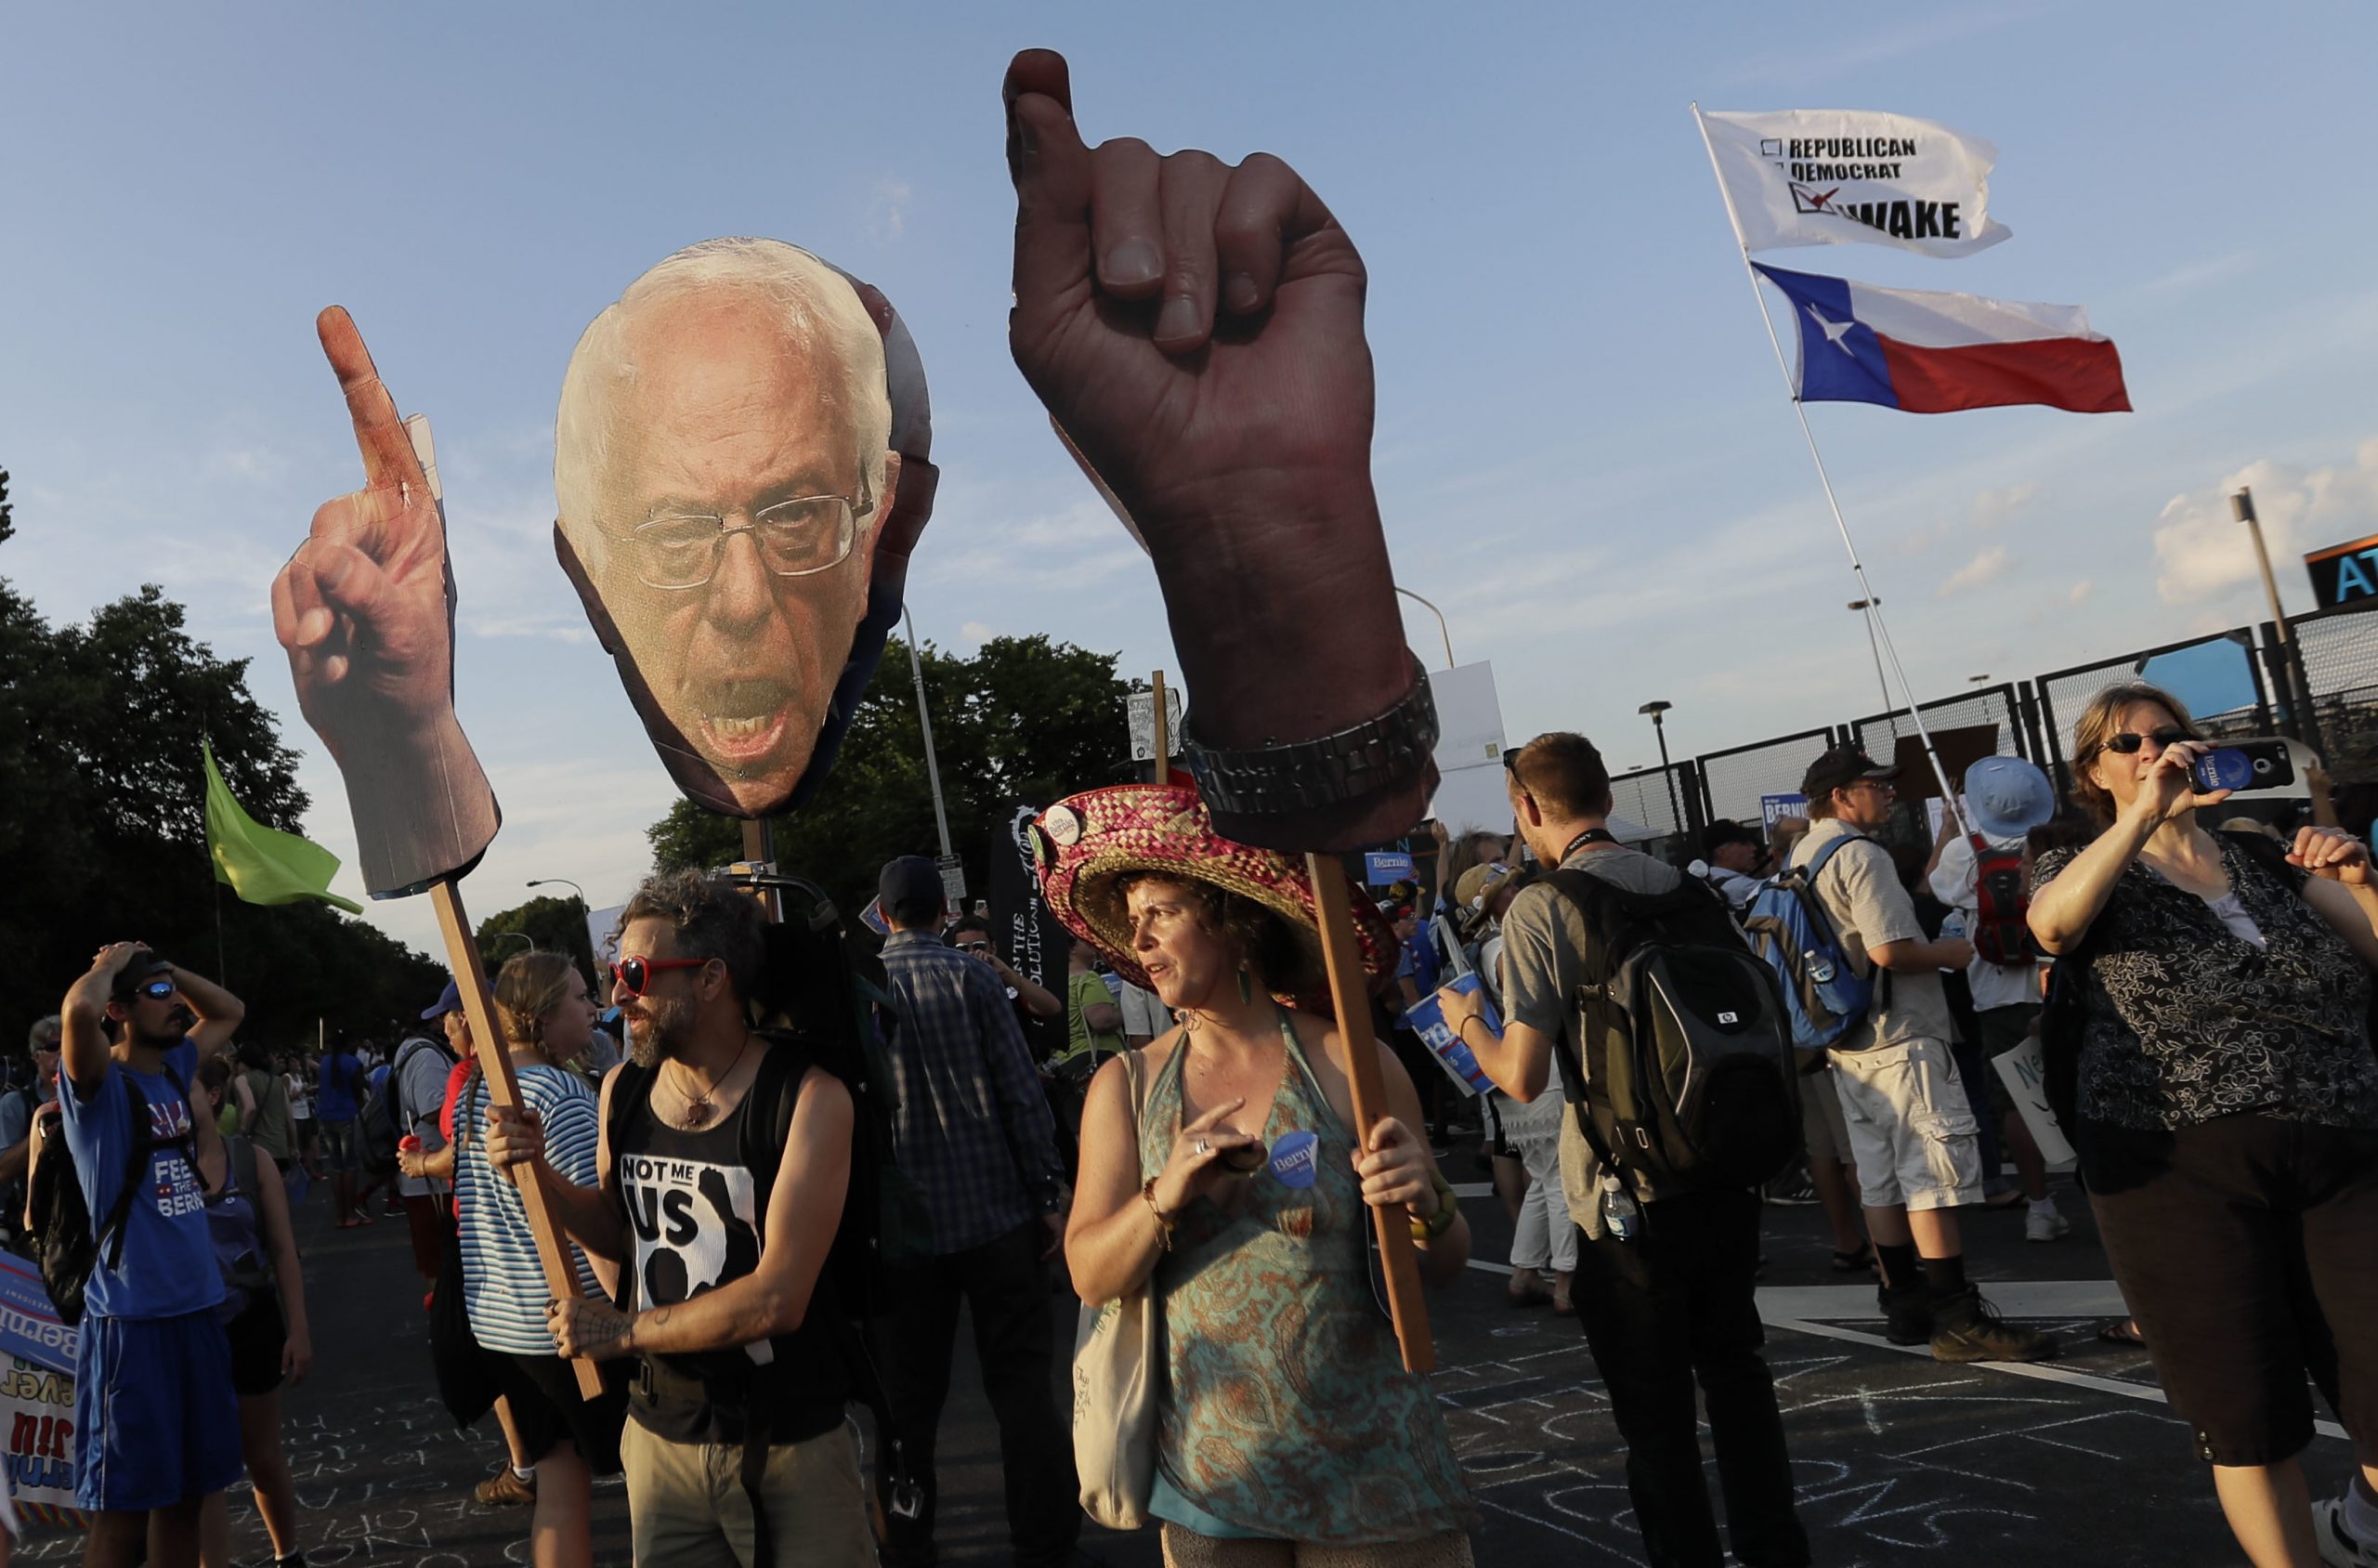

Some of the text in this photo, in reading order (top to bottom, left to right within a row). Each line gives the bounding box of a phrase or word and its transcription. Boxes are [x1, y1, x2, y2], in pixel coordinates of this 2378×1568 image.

[1789, 137, 1916, 159] REPUBLICAN
[1791, 162, 1902, 182] DEMOCRAT
[2203, 754, 2220, 787] Bernie
[1568, 833, 1591, 850] SONY
[1373, 856, 1409, 868] Bernie
[1013, 912, 1026, 954] THE
[622, 1158, 695, 1182] NOT ME
[172, 1181, 191, 1194] THE
[158, 1191, 204, 1217] BERN
[624, 1184, 699, 1248] US
